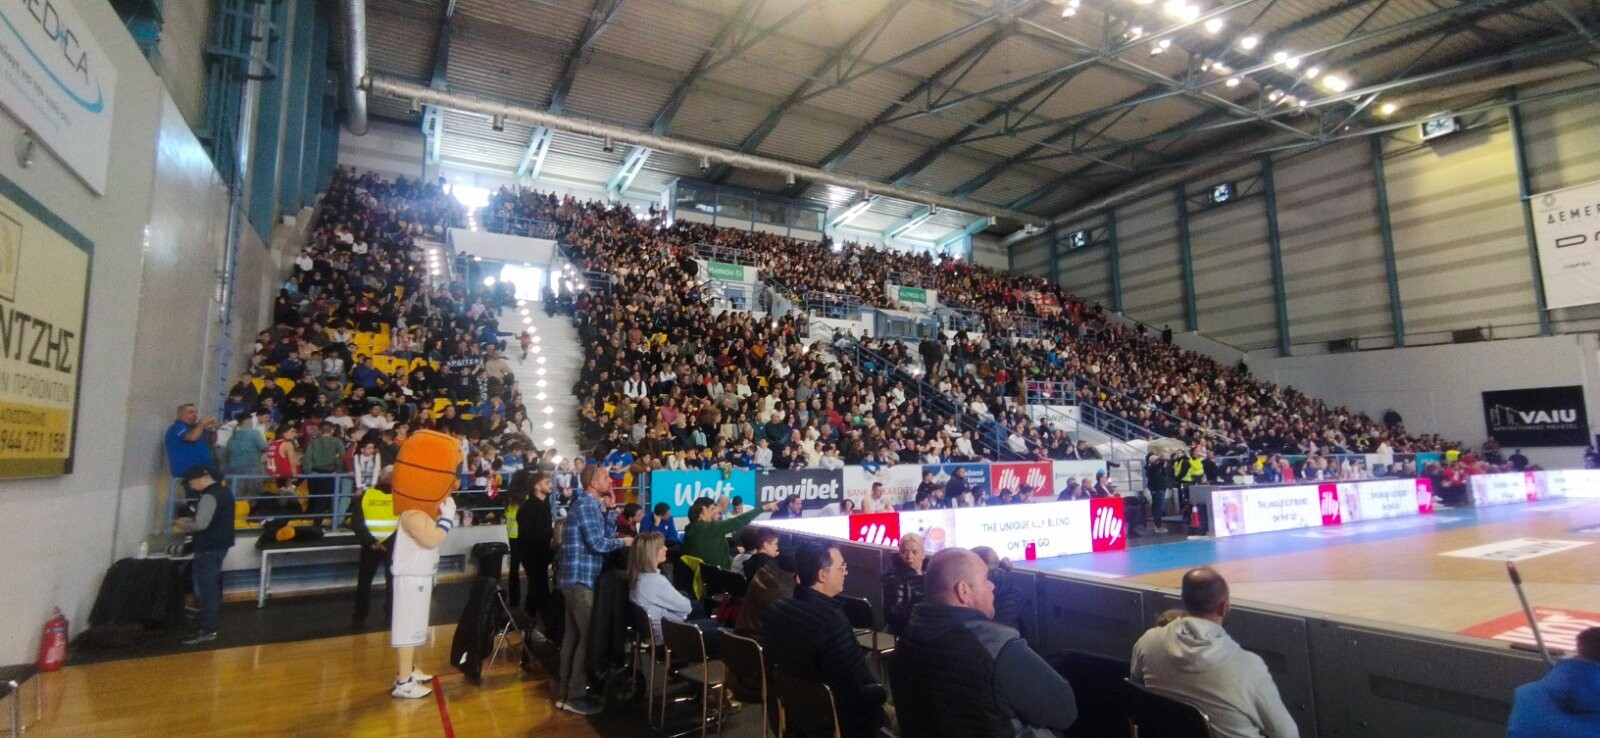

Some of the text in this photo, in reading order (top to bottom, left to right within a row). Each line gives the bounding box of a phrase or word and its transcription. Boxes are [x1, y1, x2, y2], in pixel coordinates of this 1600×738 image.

[0, 304, 74, 374] ΝΤΖΗΣ
[1520, 408, 1577, 424] VAIU
[24, 430, 44, 452] 271
[760, 477, 839, 502] novibet
[847, 488, 869, 497] BANK
[998, 468, 1021, 491] illy
[1026, 467, 1047, 493] illy
[674, 479, 735, 507] Wolt
[1321, 491, 1339, 520] illy
[982, 516, 1071, 532] THE UNIQUE ILLY BLEND
[1092, 506, 1122, 546] illy
[1007, 541, 1020, 550] ON
[1037, 538, 1050, 547] GO
